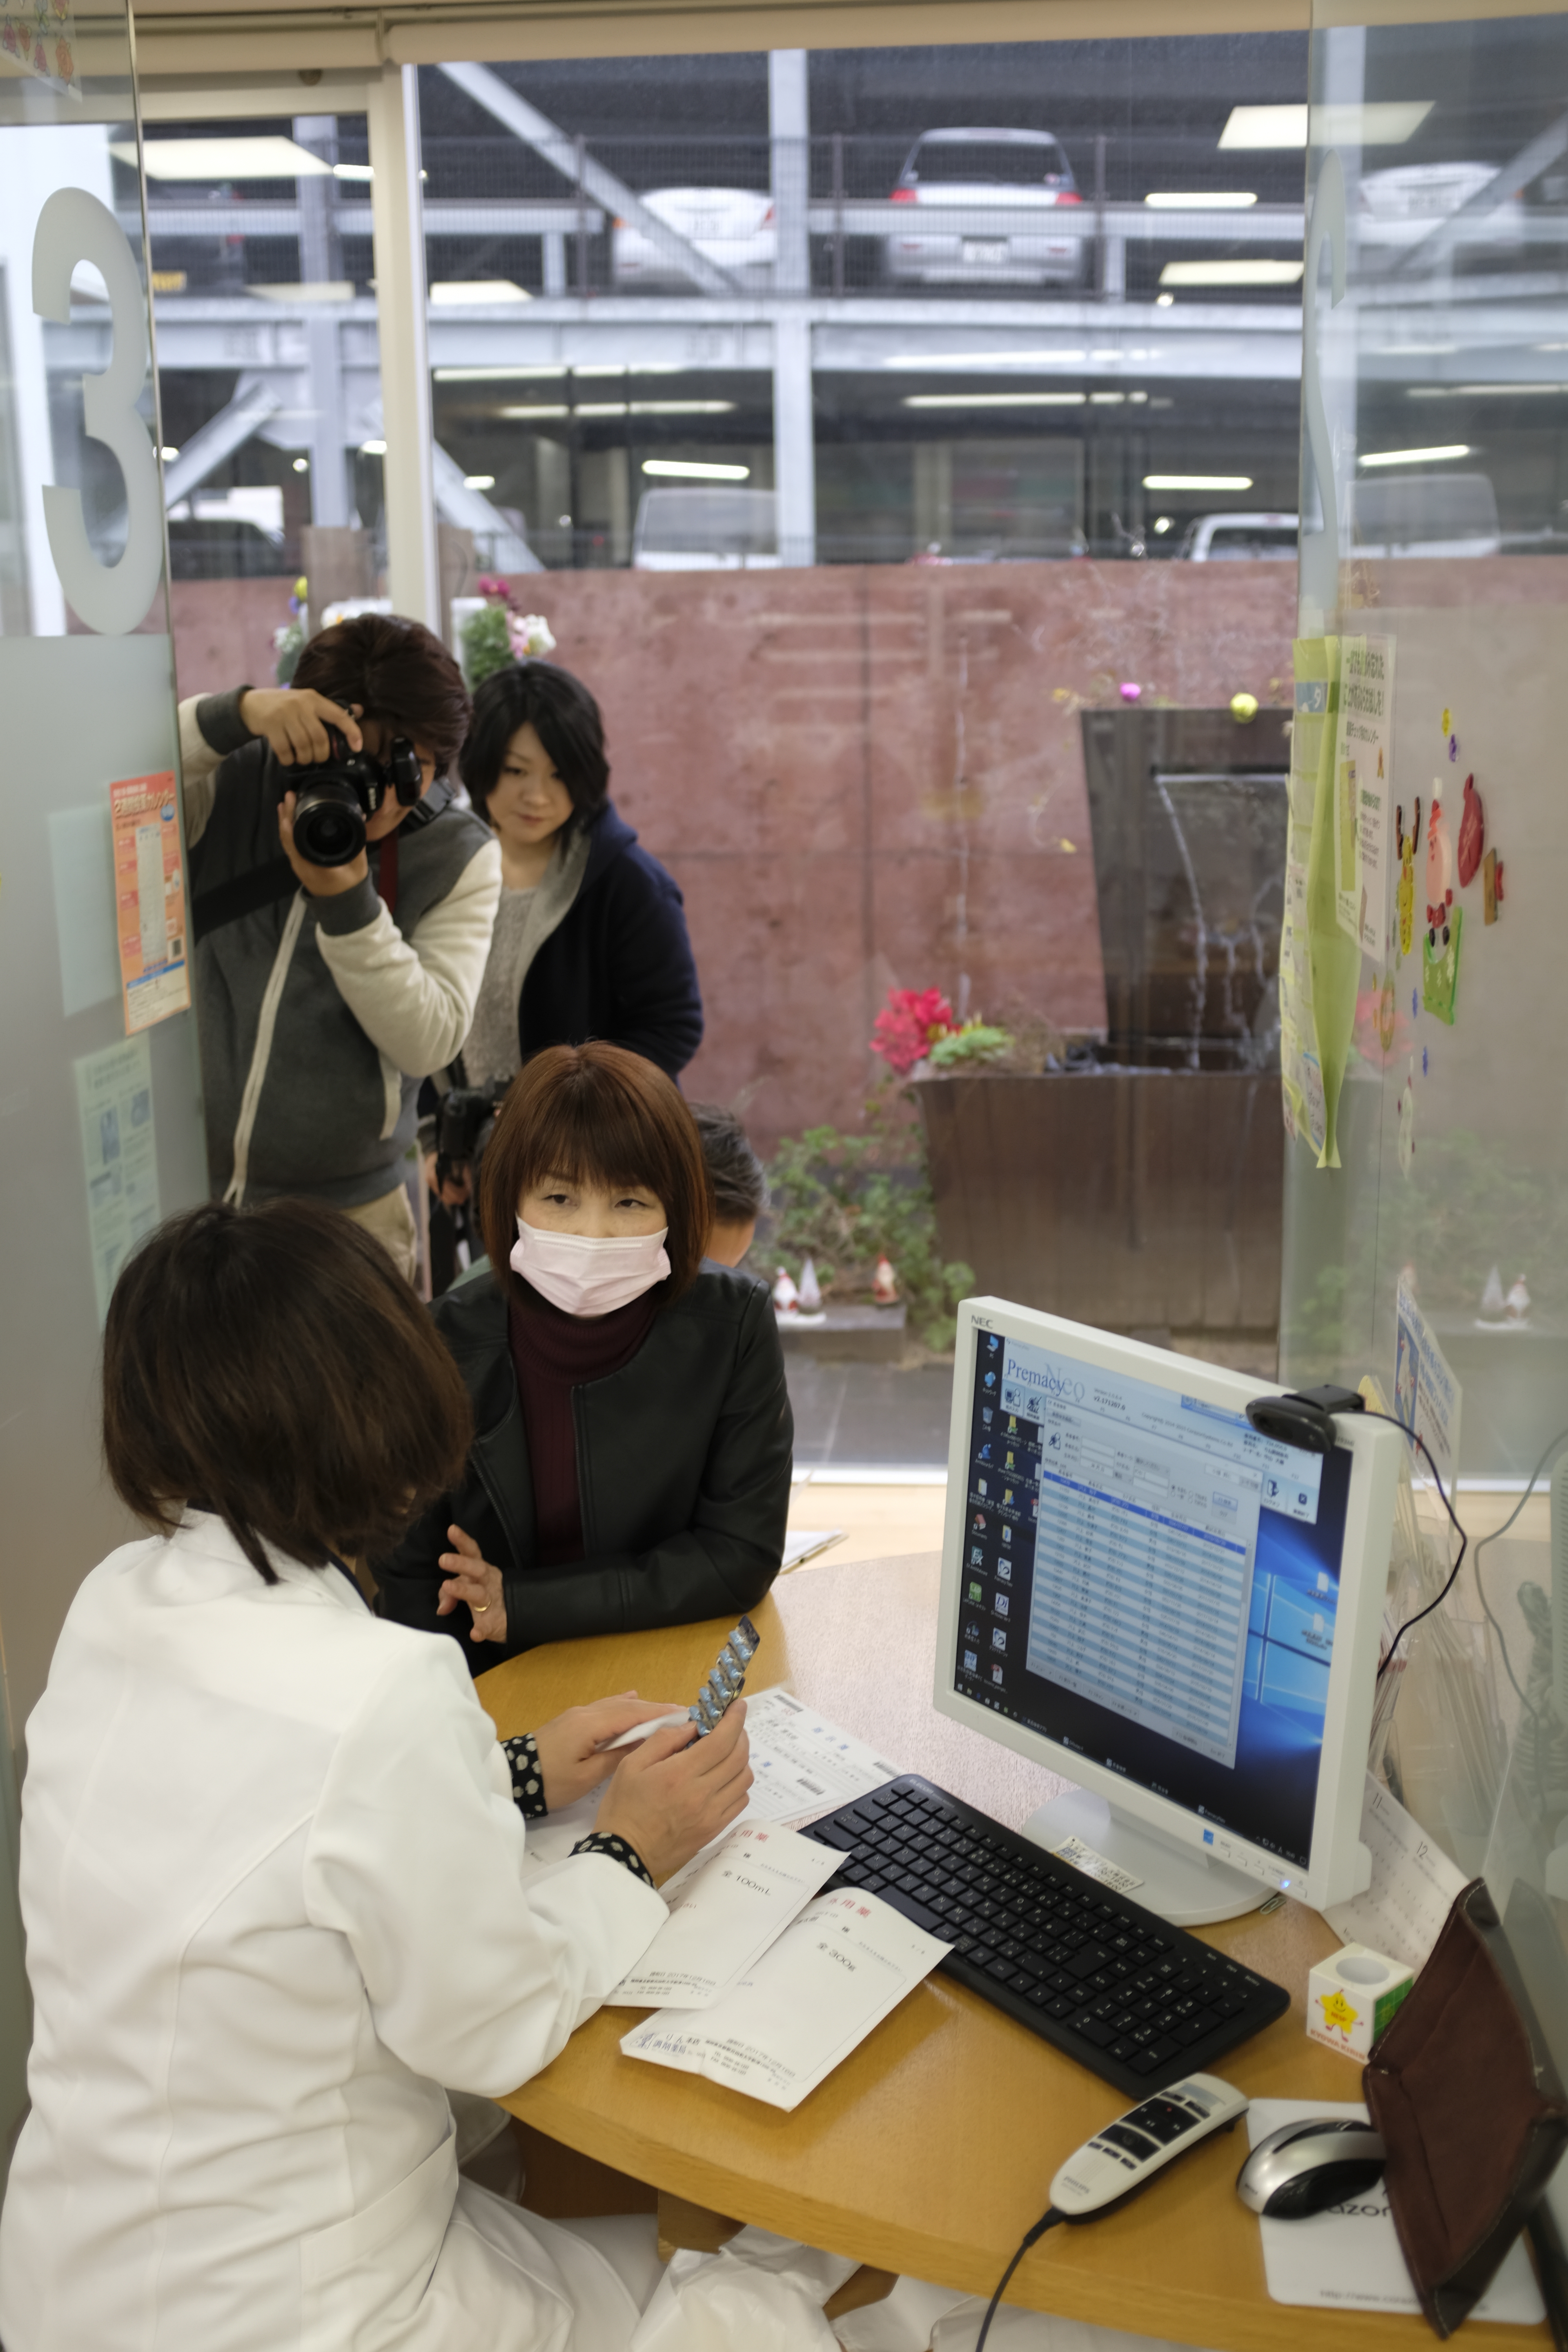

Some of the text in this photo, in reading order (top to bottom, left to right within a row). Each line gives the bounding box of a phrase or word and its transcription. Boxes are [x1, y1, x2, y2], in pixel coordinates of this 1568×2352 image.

[32, 186, 163, 635] 3
[971, 1315, 993, 1329] NEC
[1007, 1358, 1065, 1396] Premacy
[736, 1875, 771, 1896] 100mL
[829, 1949, 857, 1972] 300g
[1310, 2028, 1366, 2060] KYOWA KIRIN
[1063, 2176, 1091, 2194] PHILIPS
